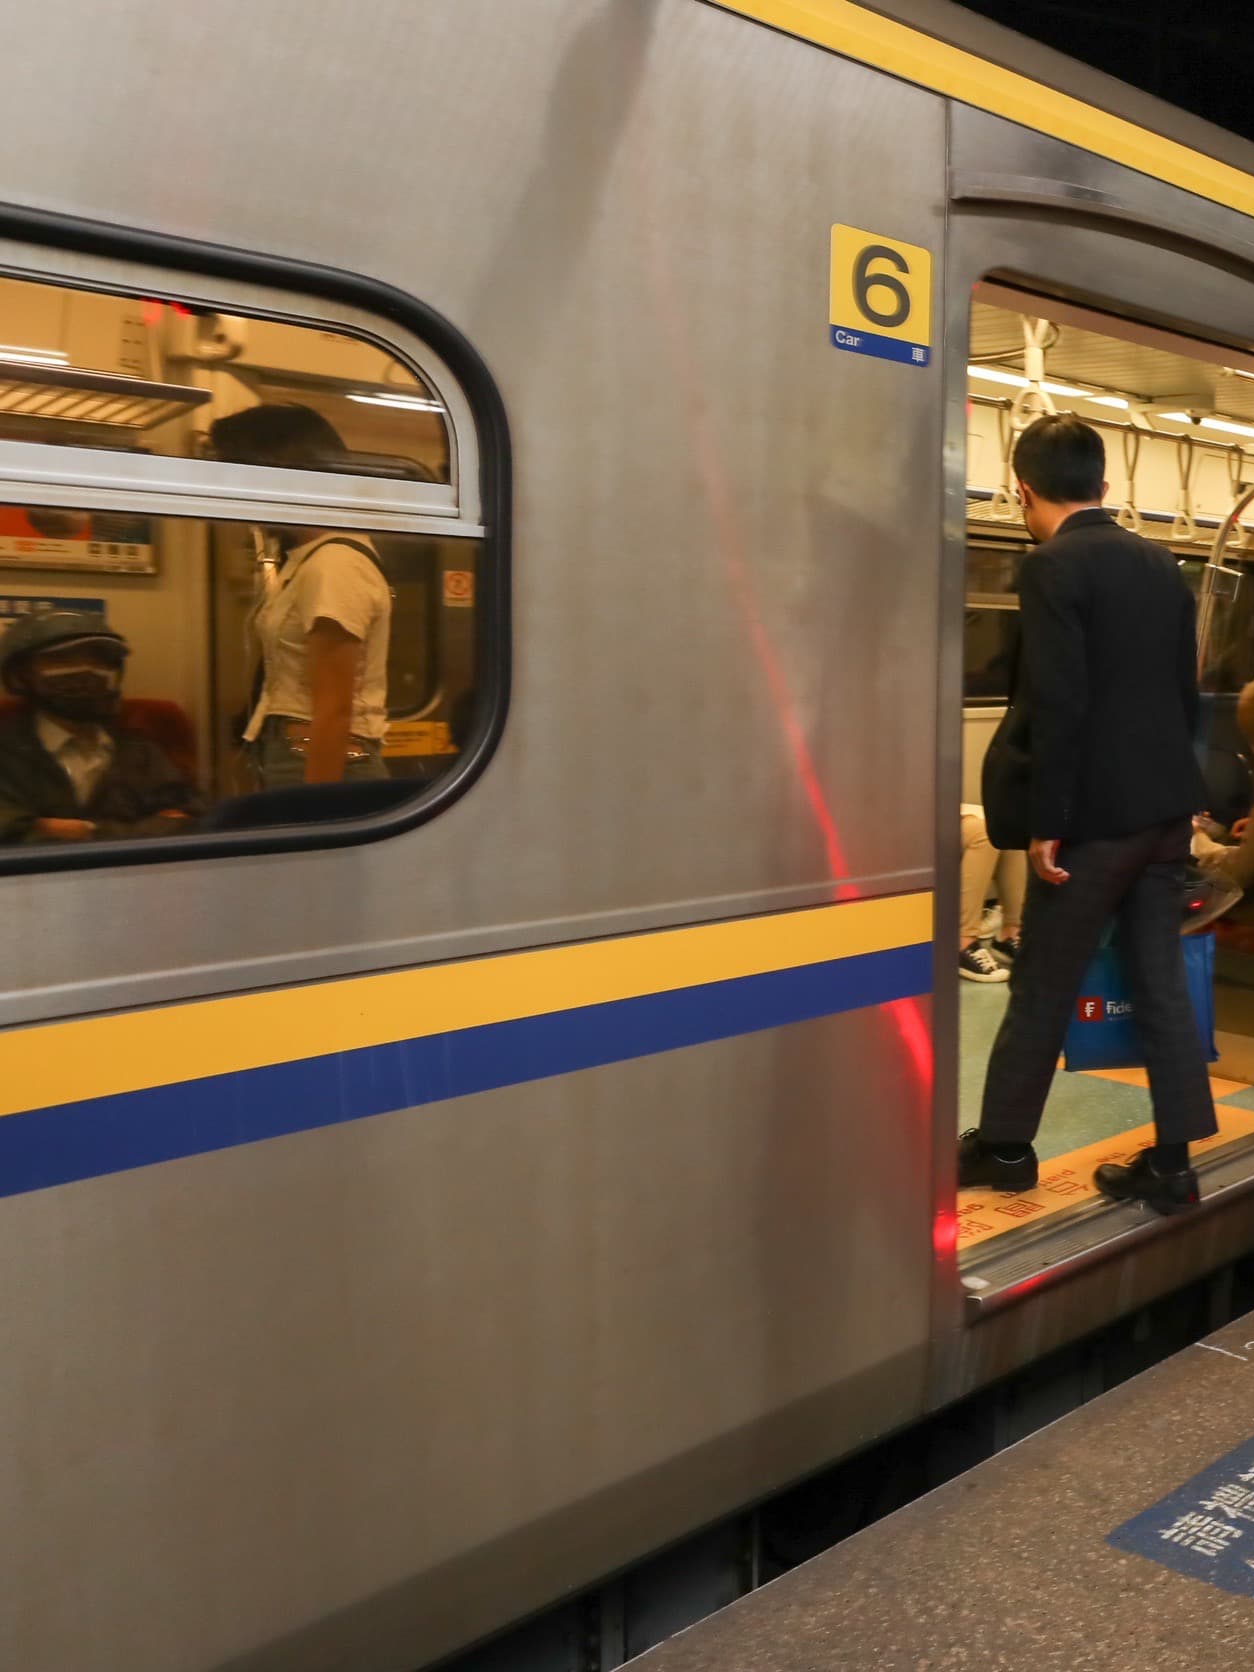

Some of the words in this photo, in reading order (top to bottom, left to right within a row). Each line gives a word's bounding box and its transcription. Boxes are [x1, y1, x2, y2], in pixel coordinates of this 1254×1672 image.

[852, 245, 910, 328] 6
[835, 329, 860, 347] Car
[911, 347, 925, 363] 車
[1106, 1000, 1136, 1015] Fide
